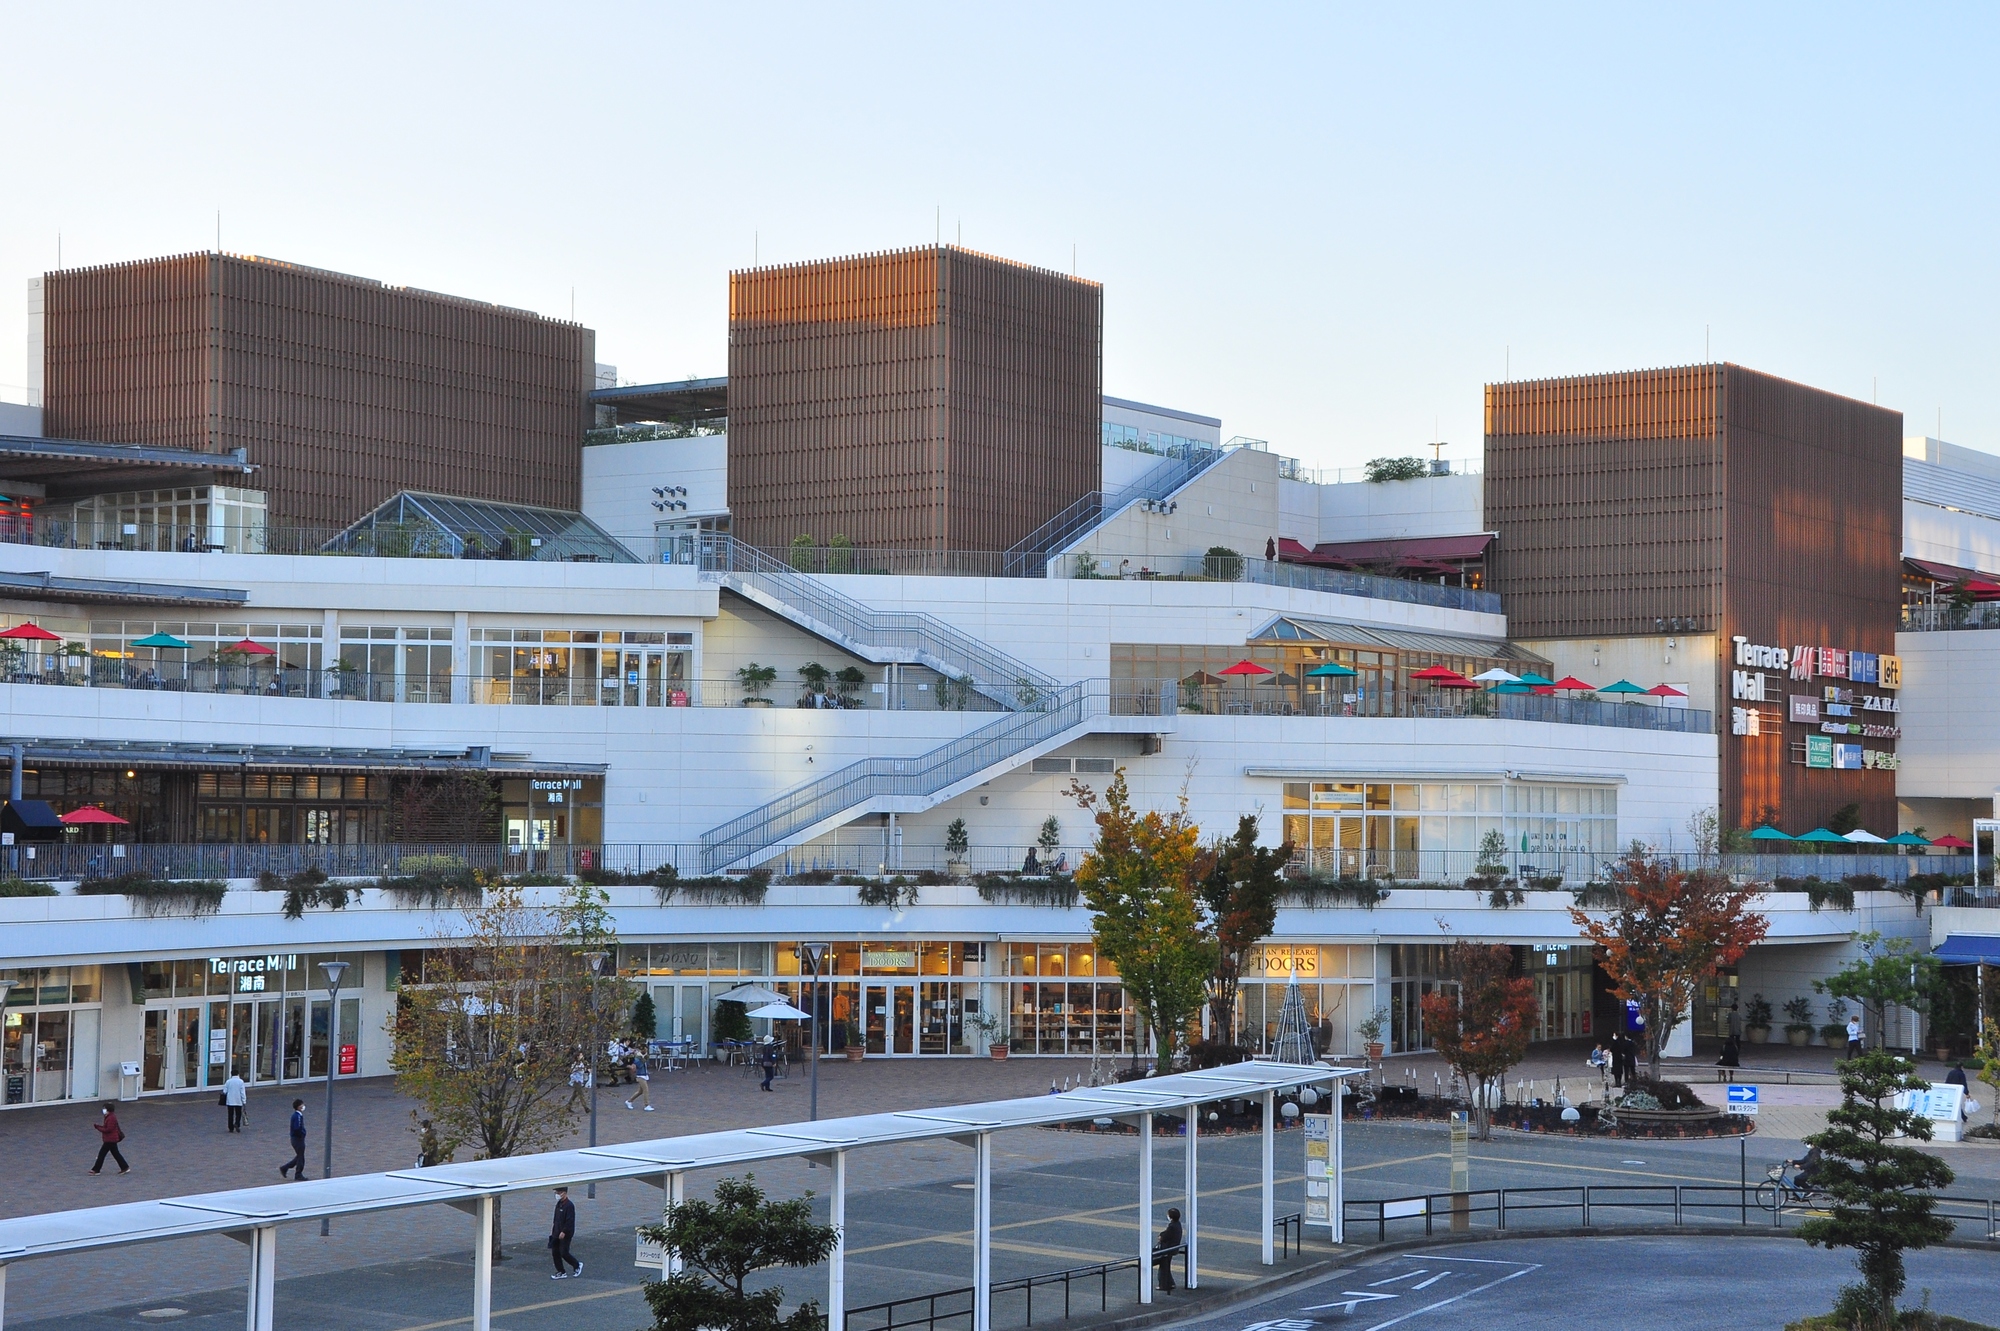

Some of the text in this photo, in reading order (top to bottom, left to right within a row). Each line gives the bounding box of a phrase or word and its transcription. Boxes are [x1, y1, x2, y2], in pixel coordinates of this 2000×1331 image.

[1733, 635, 1789, 670] Terrace
[1733, 670, 1765, 701] Mall
[1795, 702, 1817, 717] 無印良品
[1863, 695, 1901, 713] ZARA
[1733, 706, 1760, 736] 湘南
[531, 779, 561, 790] Terrace
[660, 953, 699, 965] DONQ
[1281, 948, 1318, 956] REEARC
[209, 958, 265, 974] Terrace
[869, 957, 907, 966] DOORS
[1257, 957, 1316, 971] DOORS
[240, 975, 265, 991] 湘南
[1322, 1120, 1327, 1130] 1
